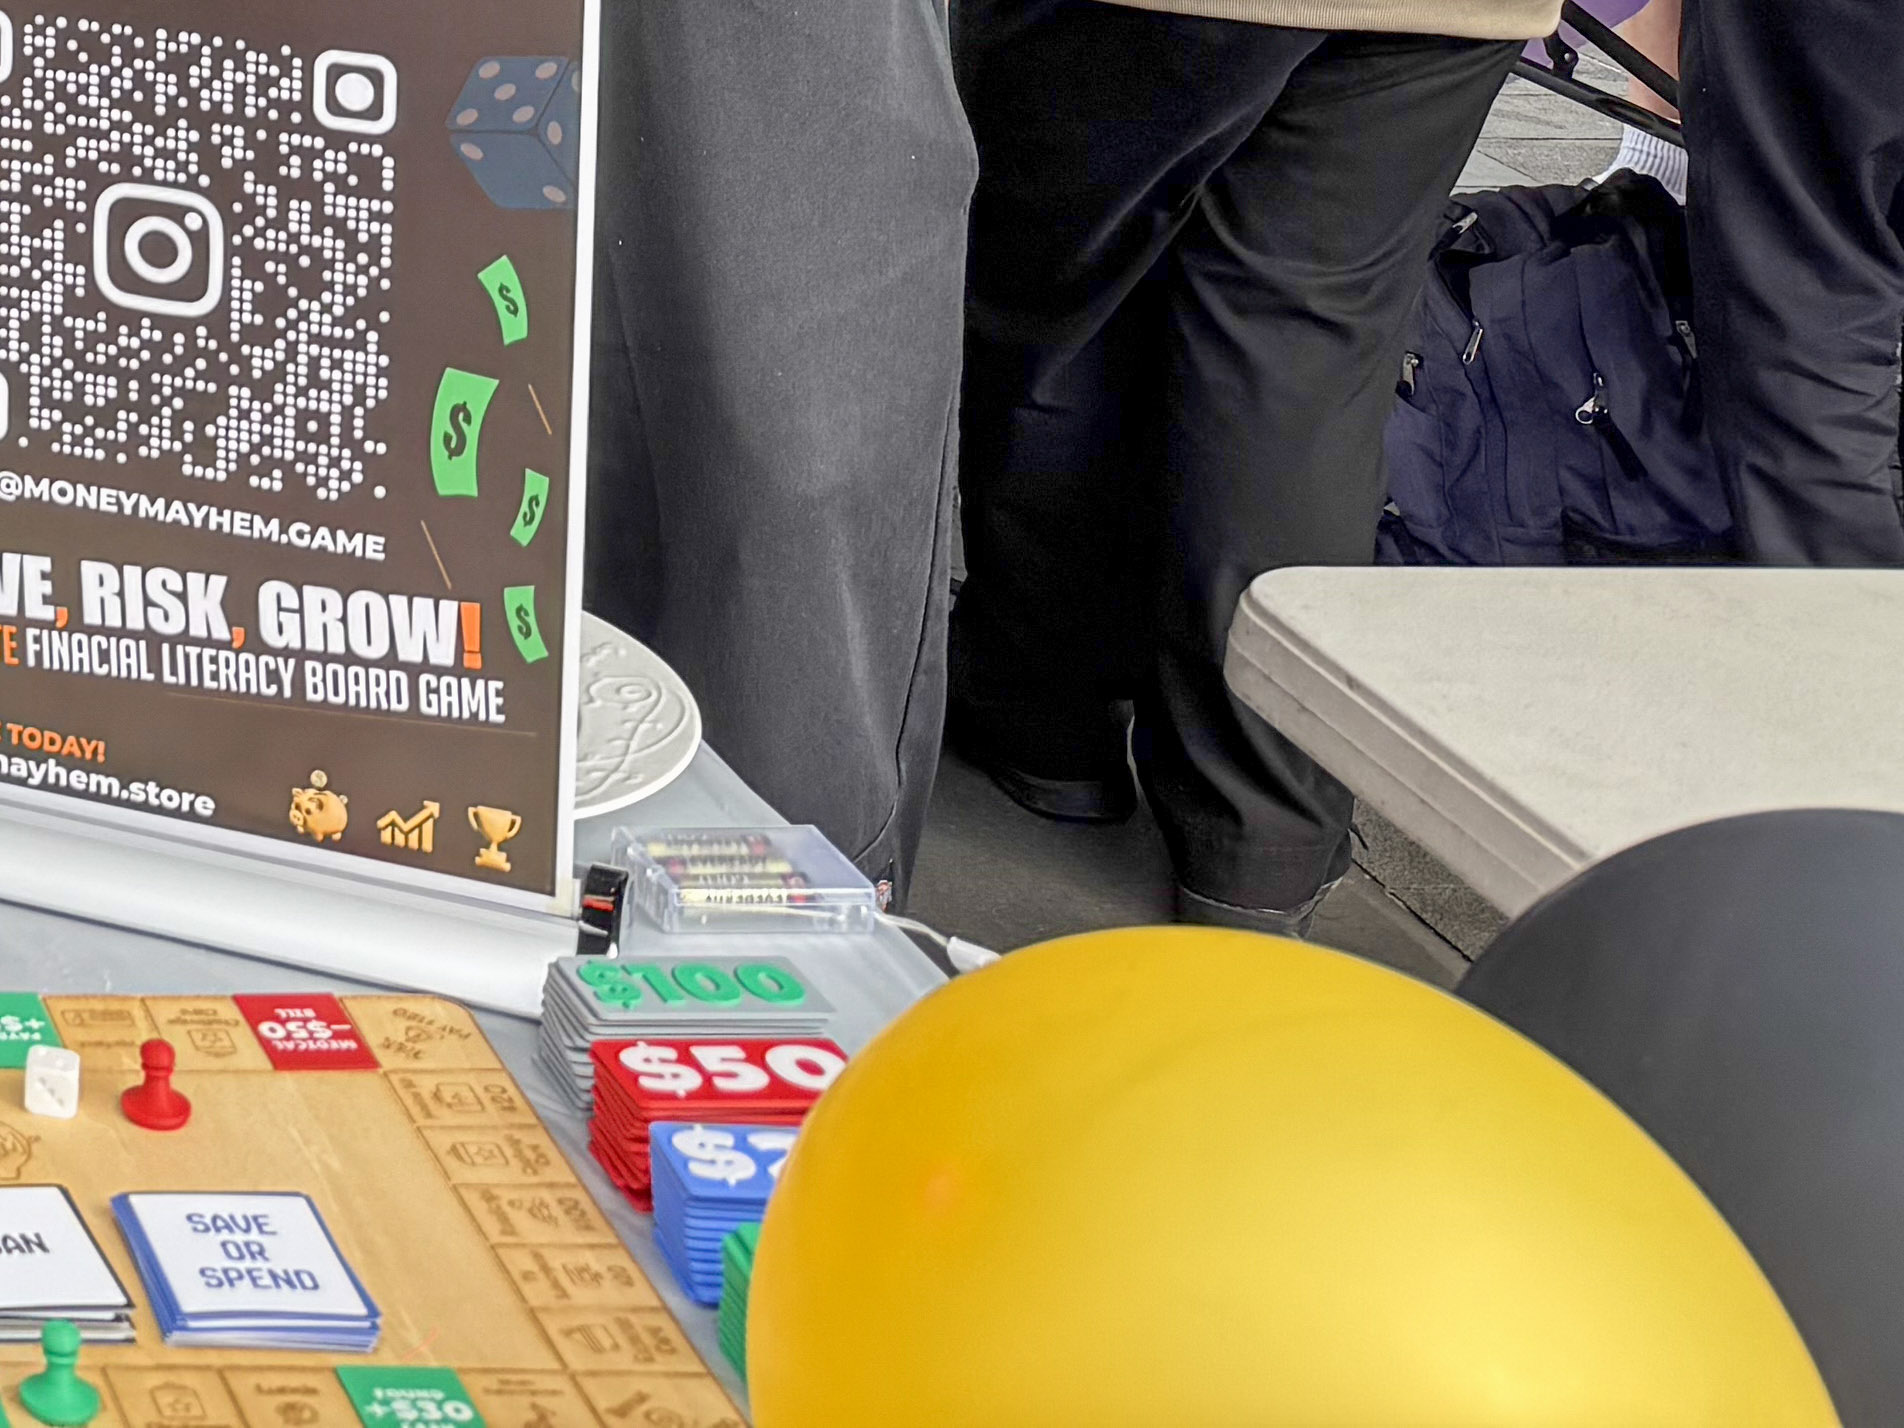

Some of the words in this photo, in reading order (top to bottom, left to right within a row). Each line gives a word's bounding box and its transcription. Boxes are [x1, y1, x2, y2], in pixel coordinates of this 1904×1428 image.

[80, 560, 246, 649] RISK,
[258, 579, 483, 669] GROW!
[25, 626, 154, 682] FINACIAL
[162, 640, 295, 700] LITERACY
[304, 660, 410, 715] BOARD
[418, 676, 507, 725] GAME
[10, 721, 106, 764] TODAY!
[577, 959, 807, 1009] $100
[271, 1039, 357, 1051] MEDICAL
[619, 1040, 849, 1098] $50
[184, 1210, 278, 1239] SAVE
[220, 1238, 272, 1264] OR
[196, 1265, 320, 1294] SPEND
